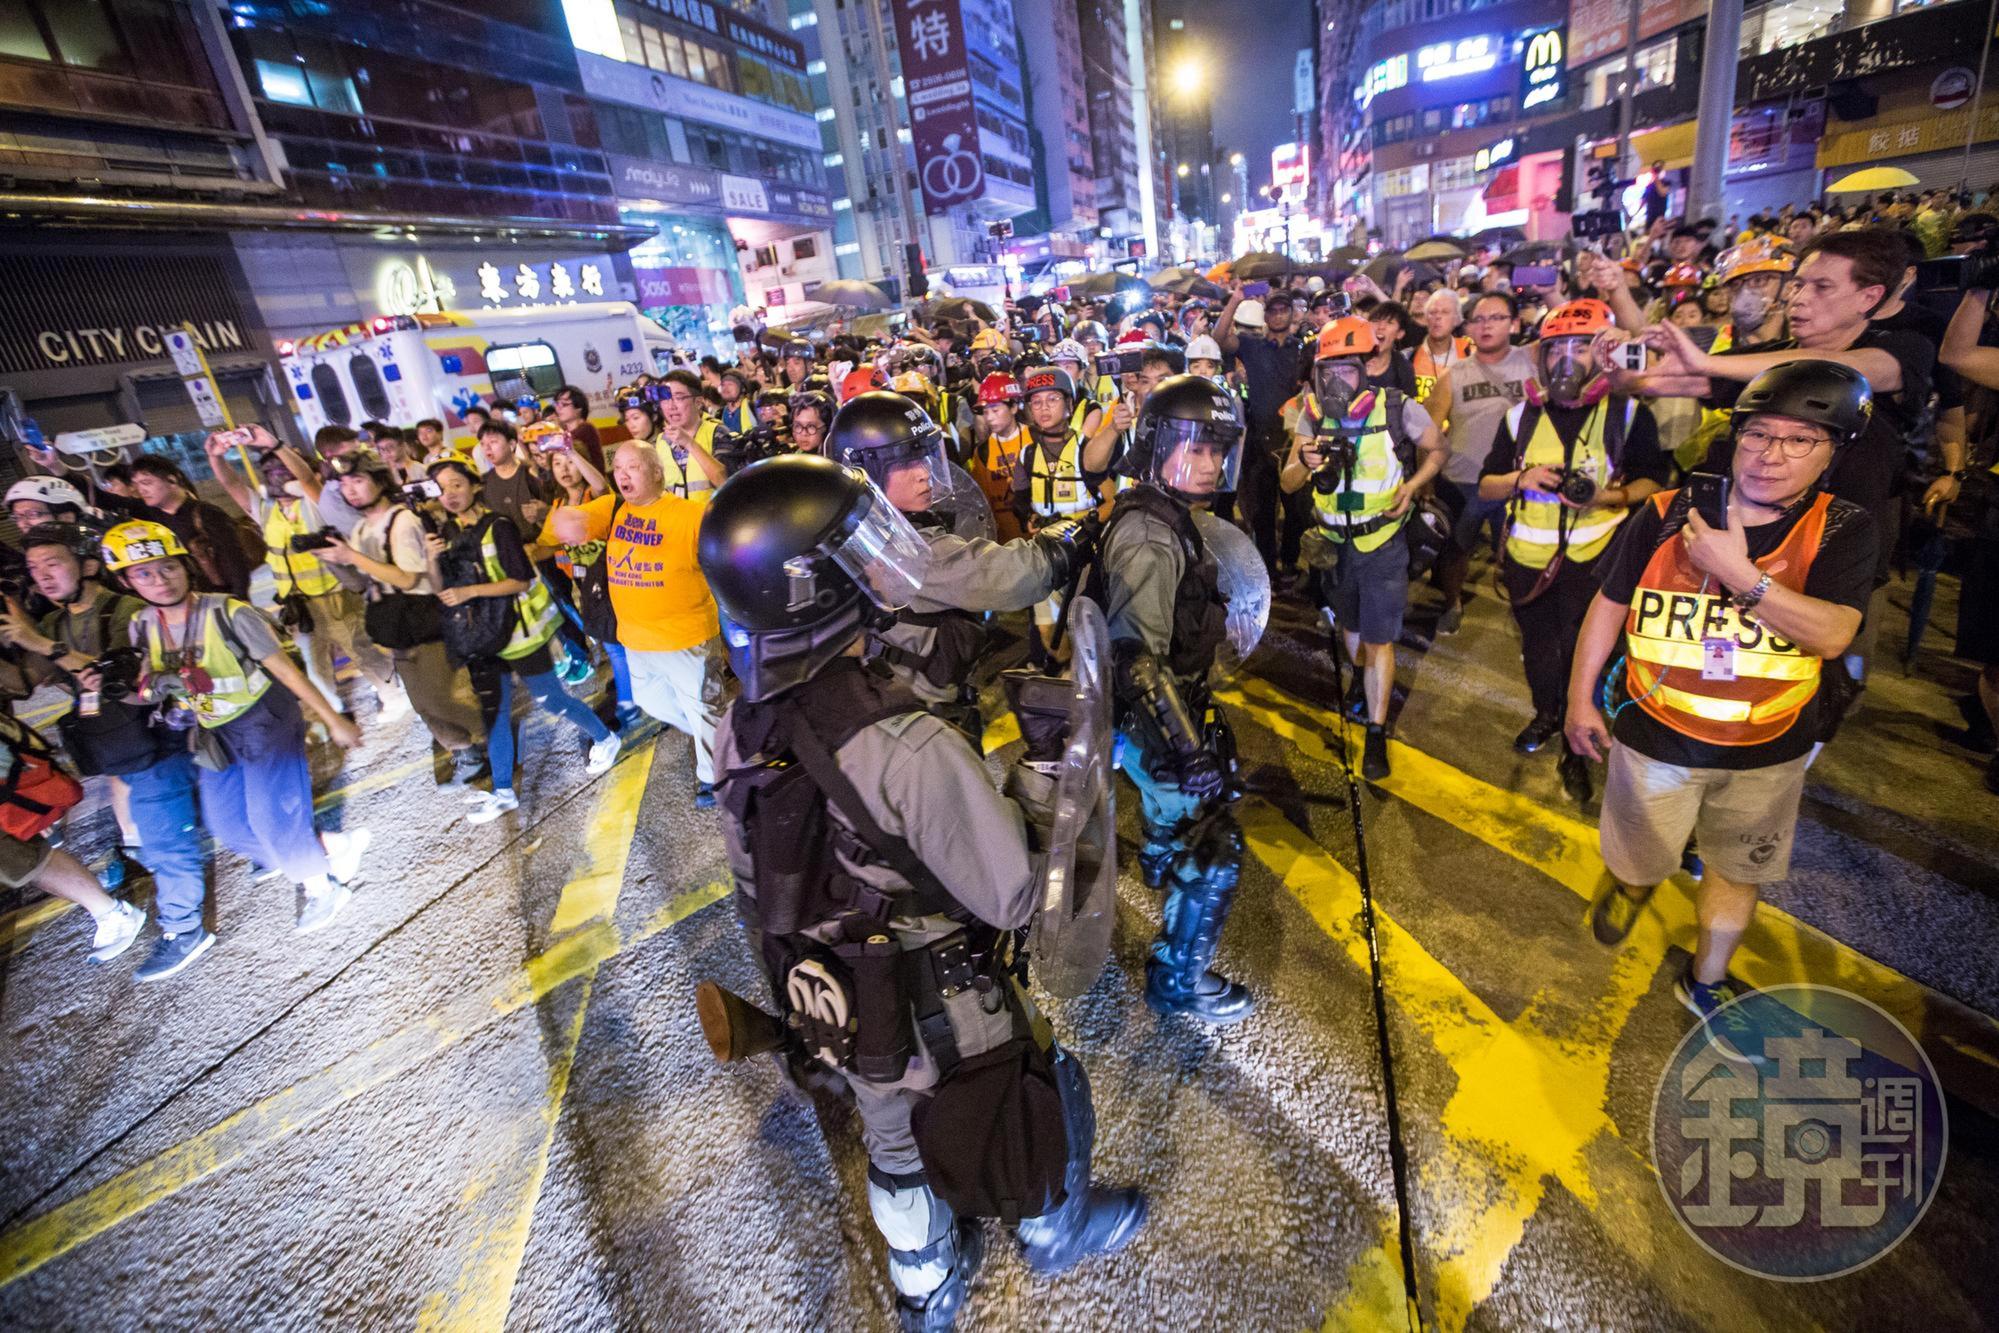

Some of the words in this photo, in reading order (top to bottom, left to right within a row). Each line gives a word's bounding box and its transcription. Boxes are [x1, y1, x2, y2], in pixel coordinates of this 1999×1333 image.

[907, 0, 950, 60] 特
[729, 191, 764, 208] SALE
[38, 327, 126, 362] CITY
[134, 319, 242, 355] CAIN
[620, 362, 644, 376] A232
